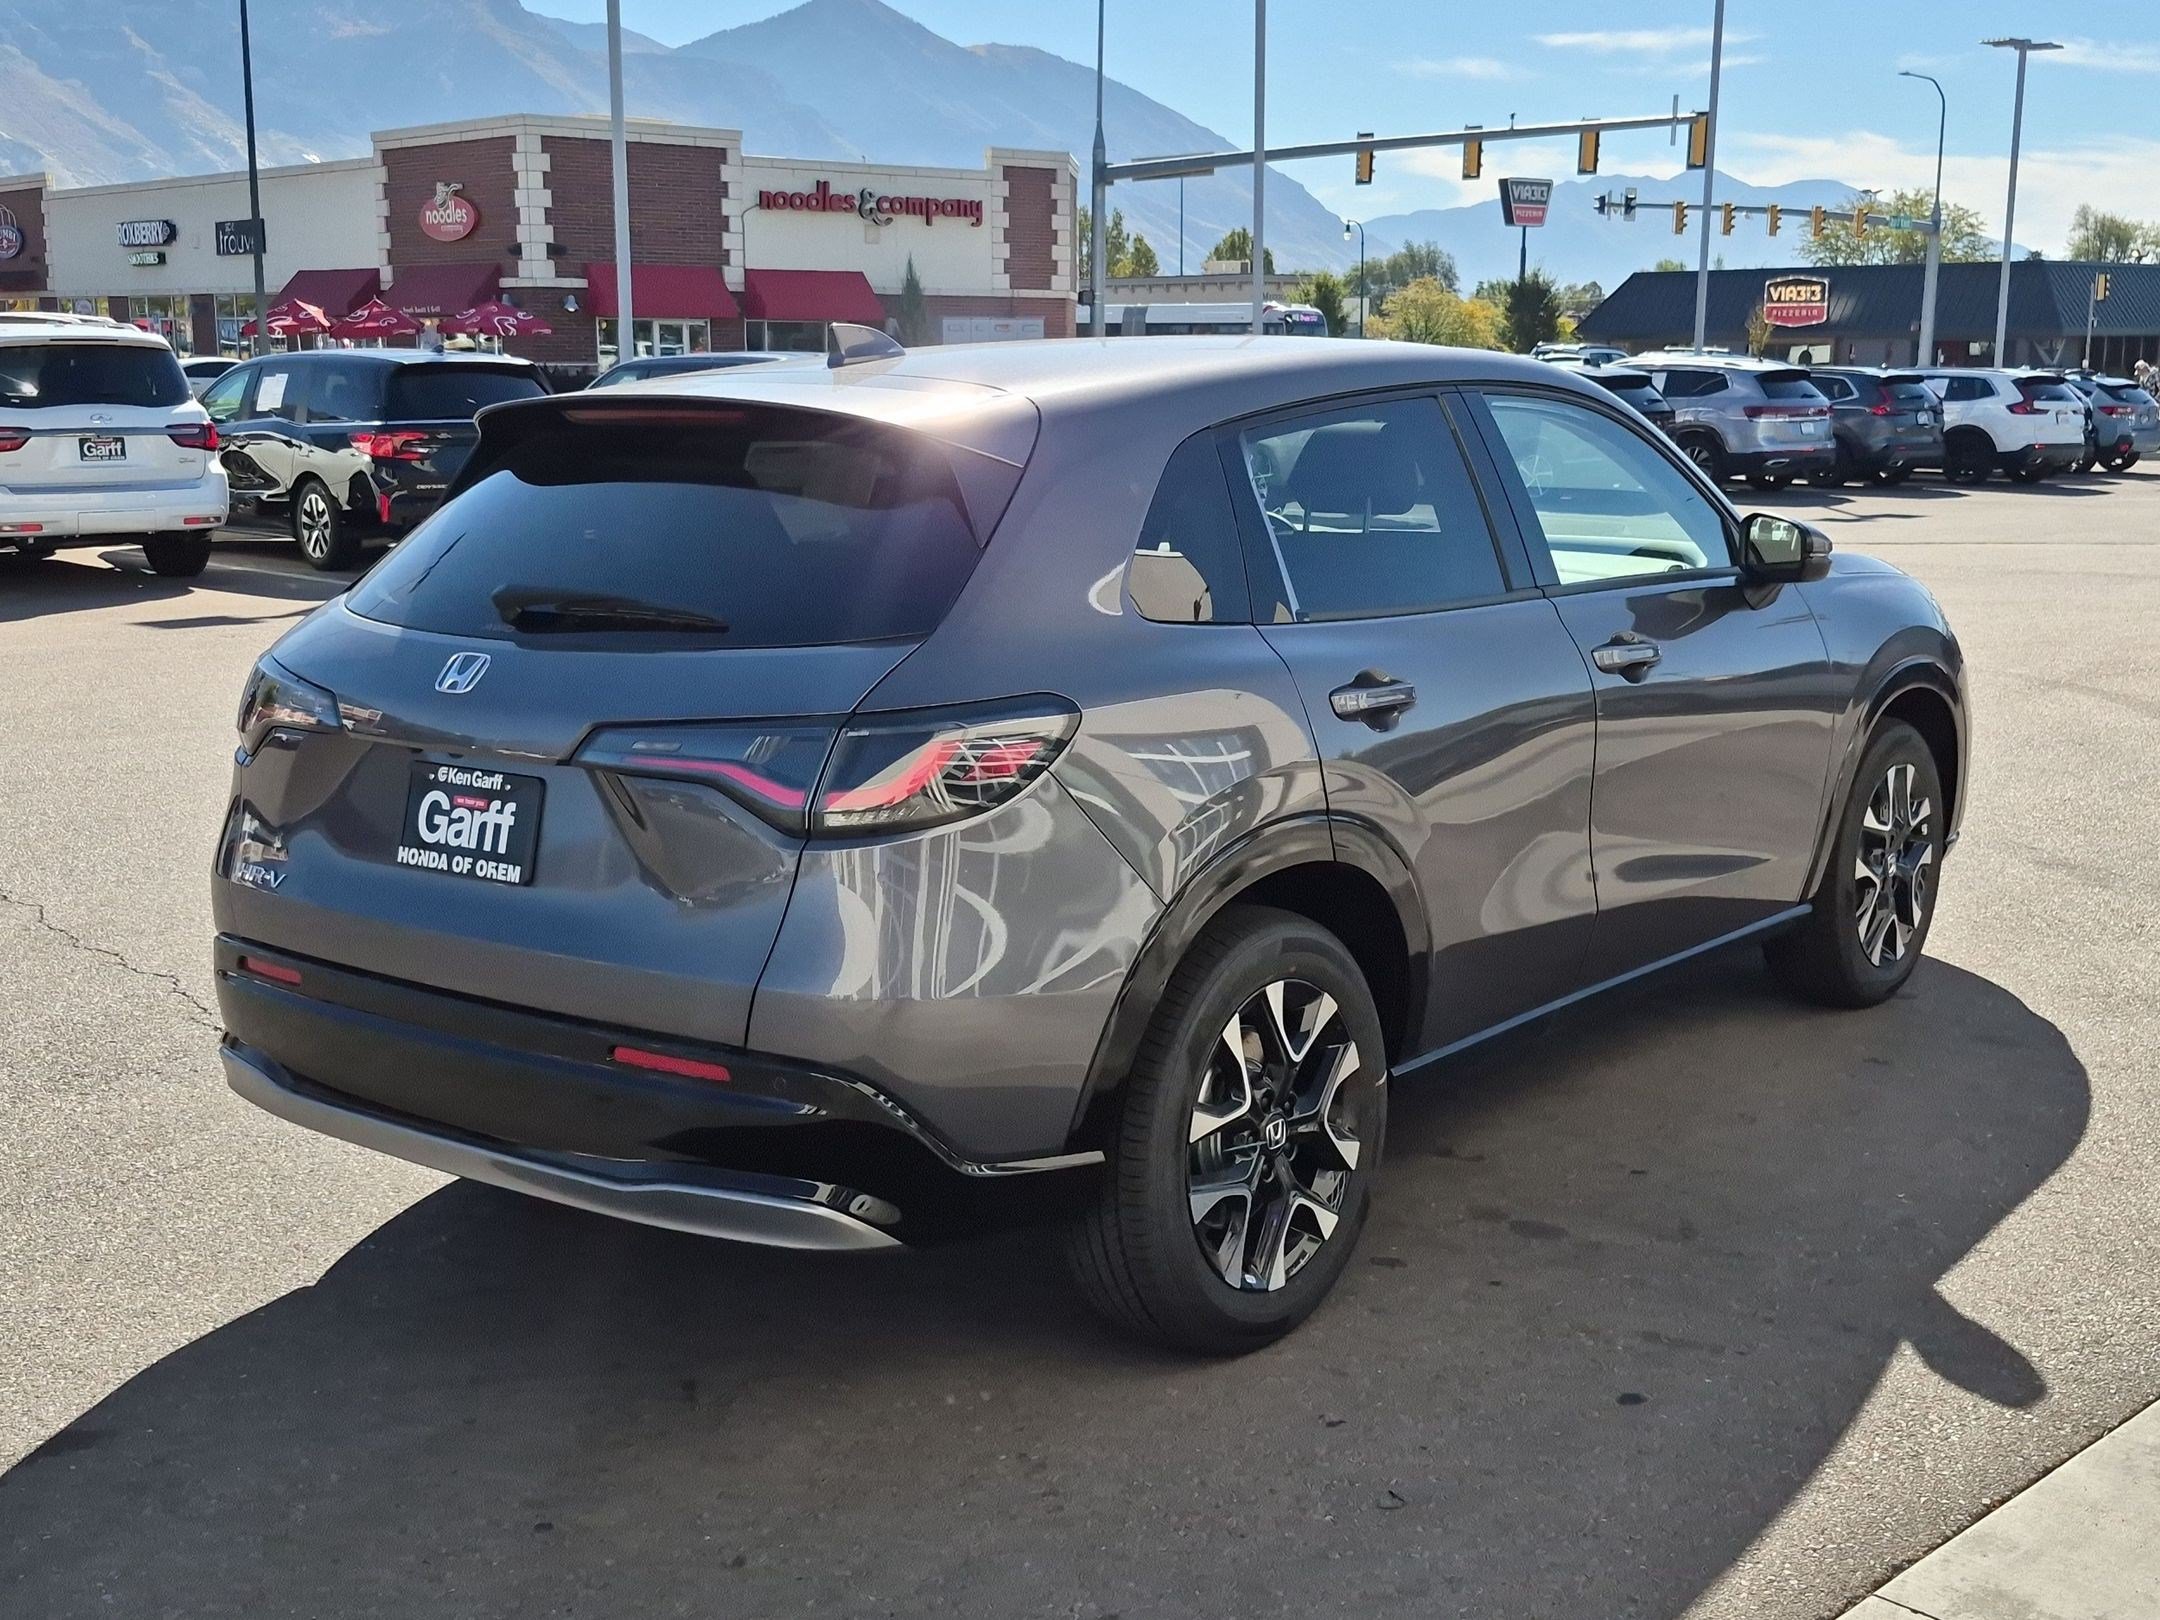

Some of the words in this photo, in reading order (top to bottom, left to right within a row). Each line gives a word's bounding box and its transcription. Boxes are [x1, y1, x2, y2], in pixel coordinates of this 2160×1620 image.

[425, 200, 467, 225] noodles
[759, 180, 856, 213] noodles
[858, 187, 893, 226] &
[876, 195, 983, 227] company
[116, 220, 163, 245] ROXBERRY
[219, 230, 254, 255] trouv
[1772, 309, 1818, 317] PIZZERIA
[83, 442, 122, 456] Garff
[448, 768, 471, 786] Ken
[472, 771, 503, 790] Garff
[418, 790, 517, 854] Garff
[240, 863, 287, 888] HR-V
[397, 846, 448, 870] HONDA
[451, 855, 473, 874] OF
[475, 860, 521, 883] OREM
